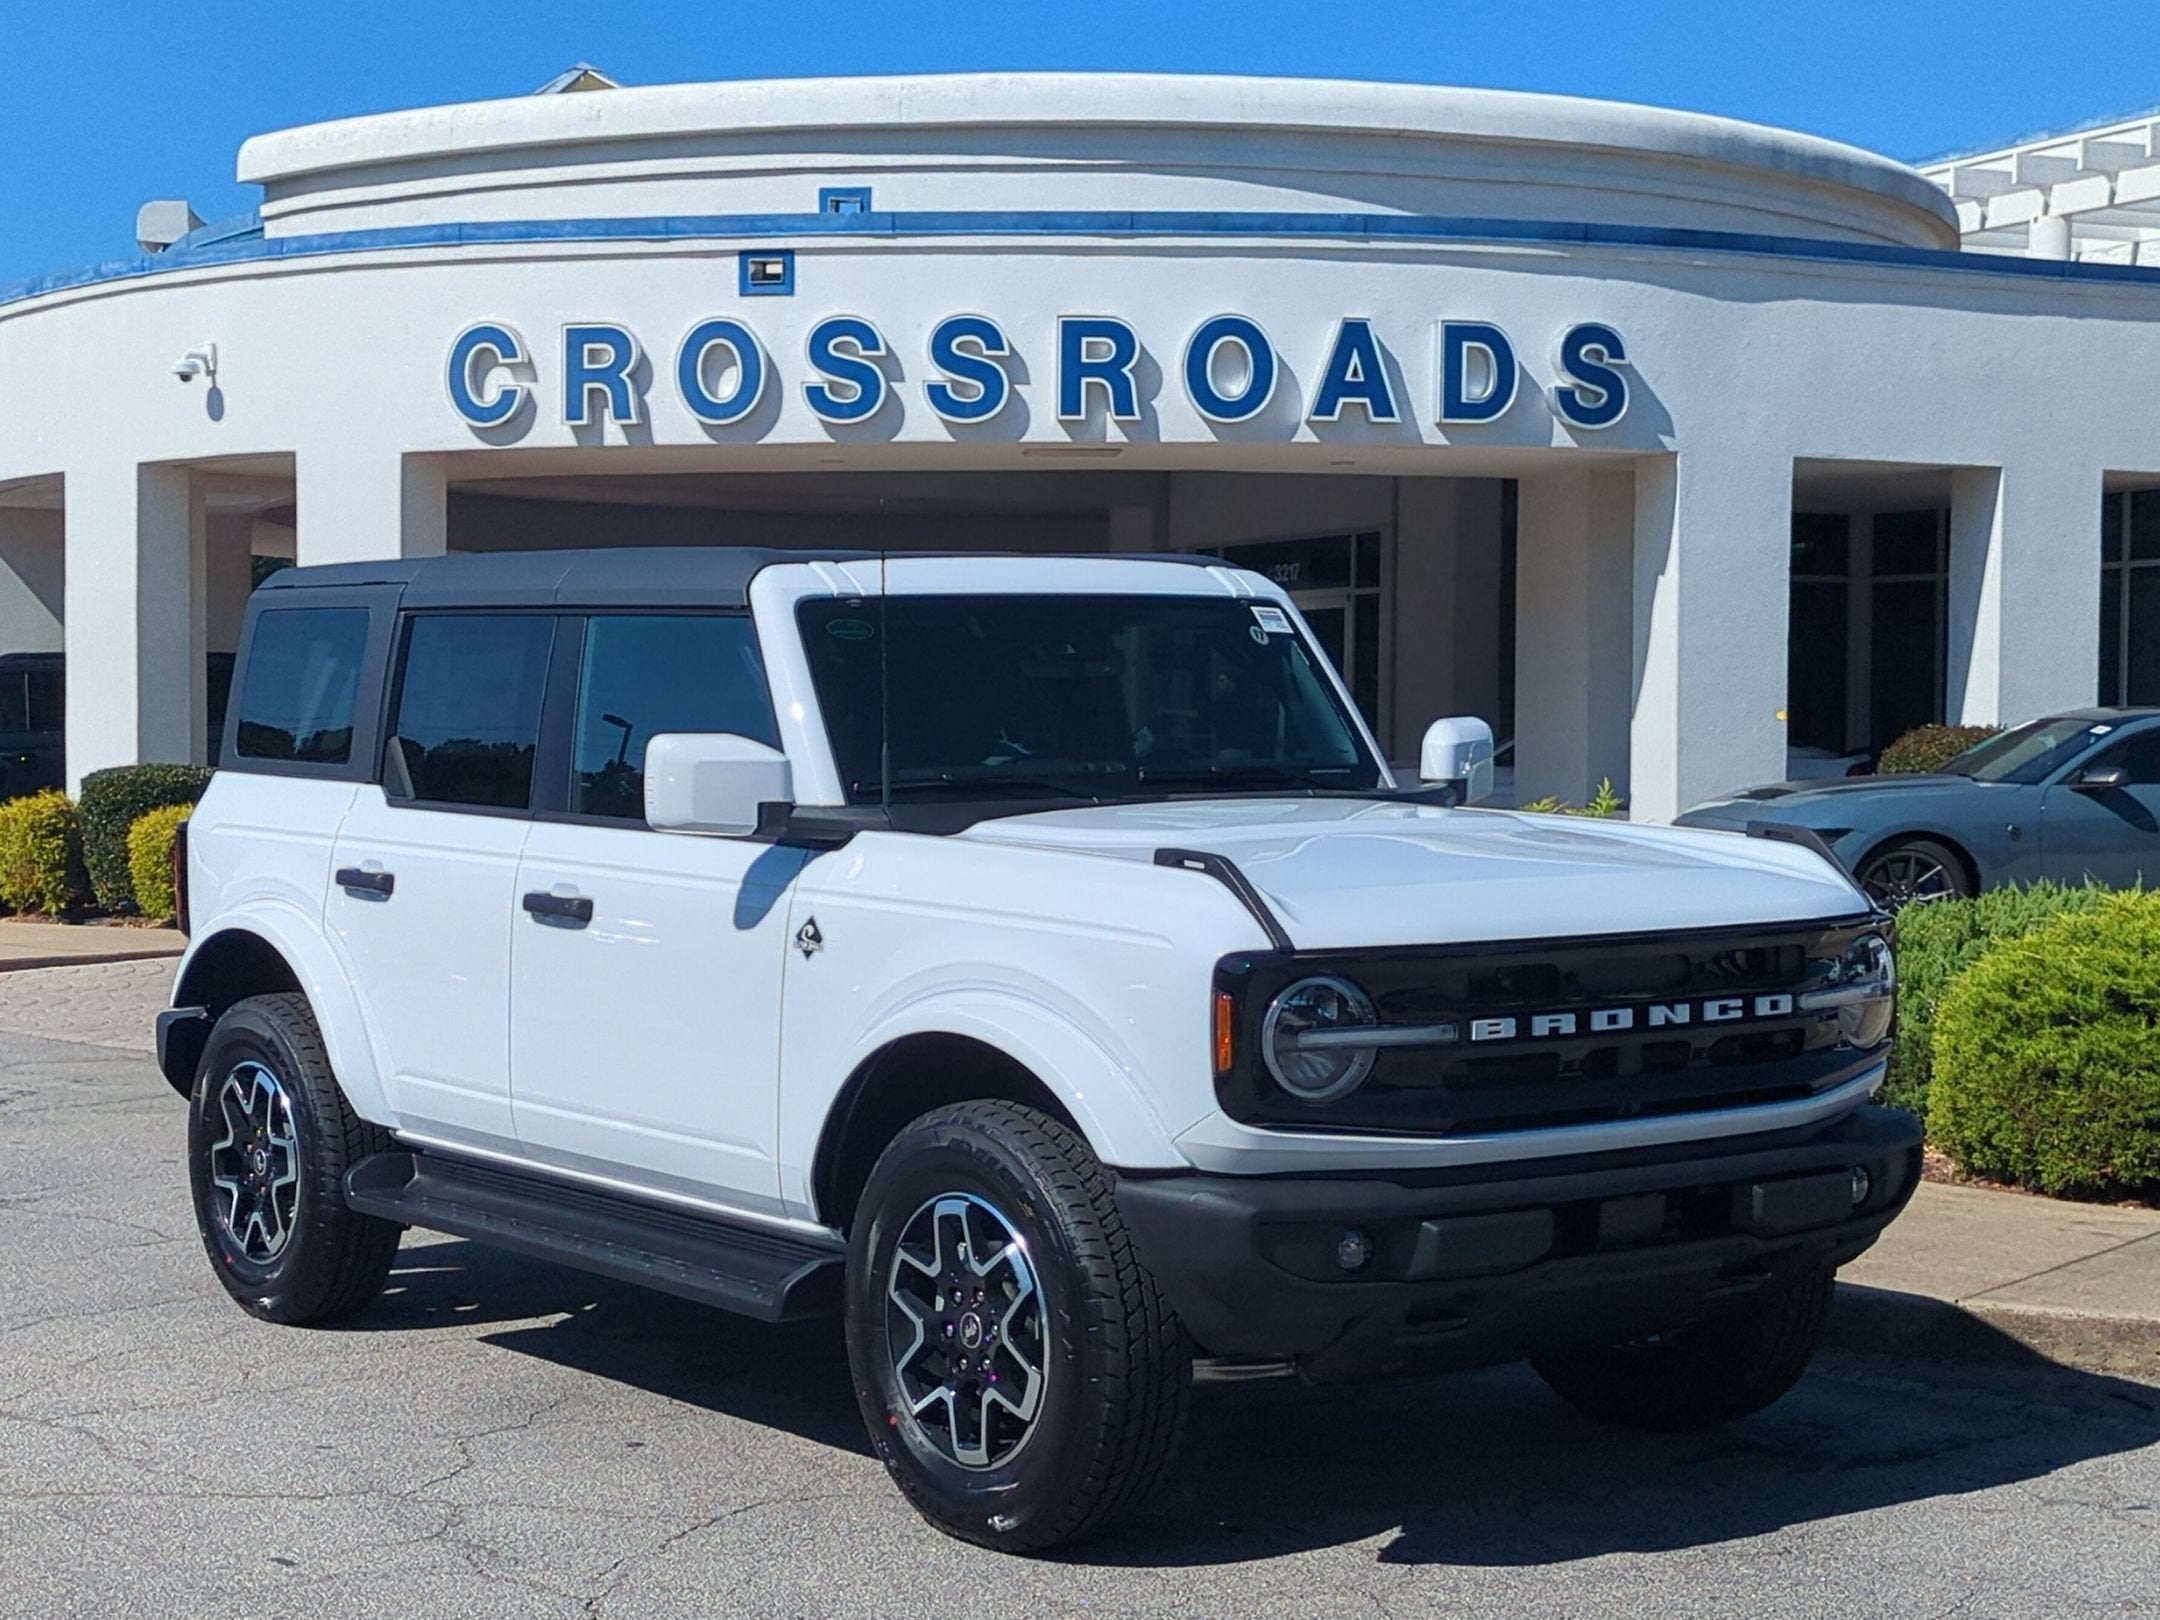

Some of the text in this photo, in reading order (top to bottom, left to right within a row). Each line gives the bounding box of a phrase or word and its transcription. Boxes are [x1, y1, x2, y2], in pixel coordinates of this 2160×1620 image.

[445, 312, 1630, 429] CROSSROADS
[1274, 562, 1300, 582] 3217
[1470, 993, 1793, 1041] BRONCO
